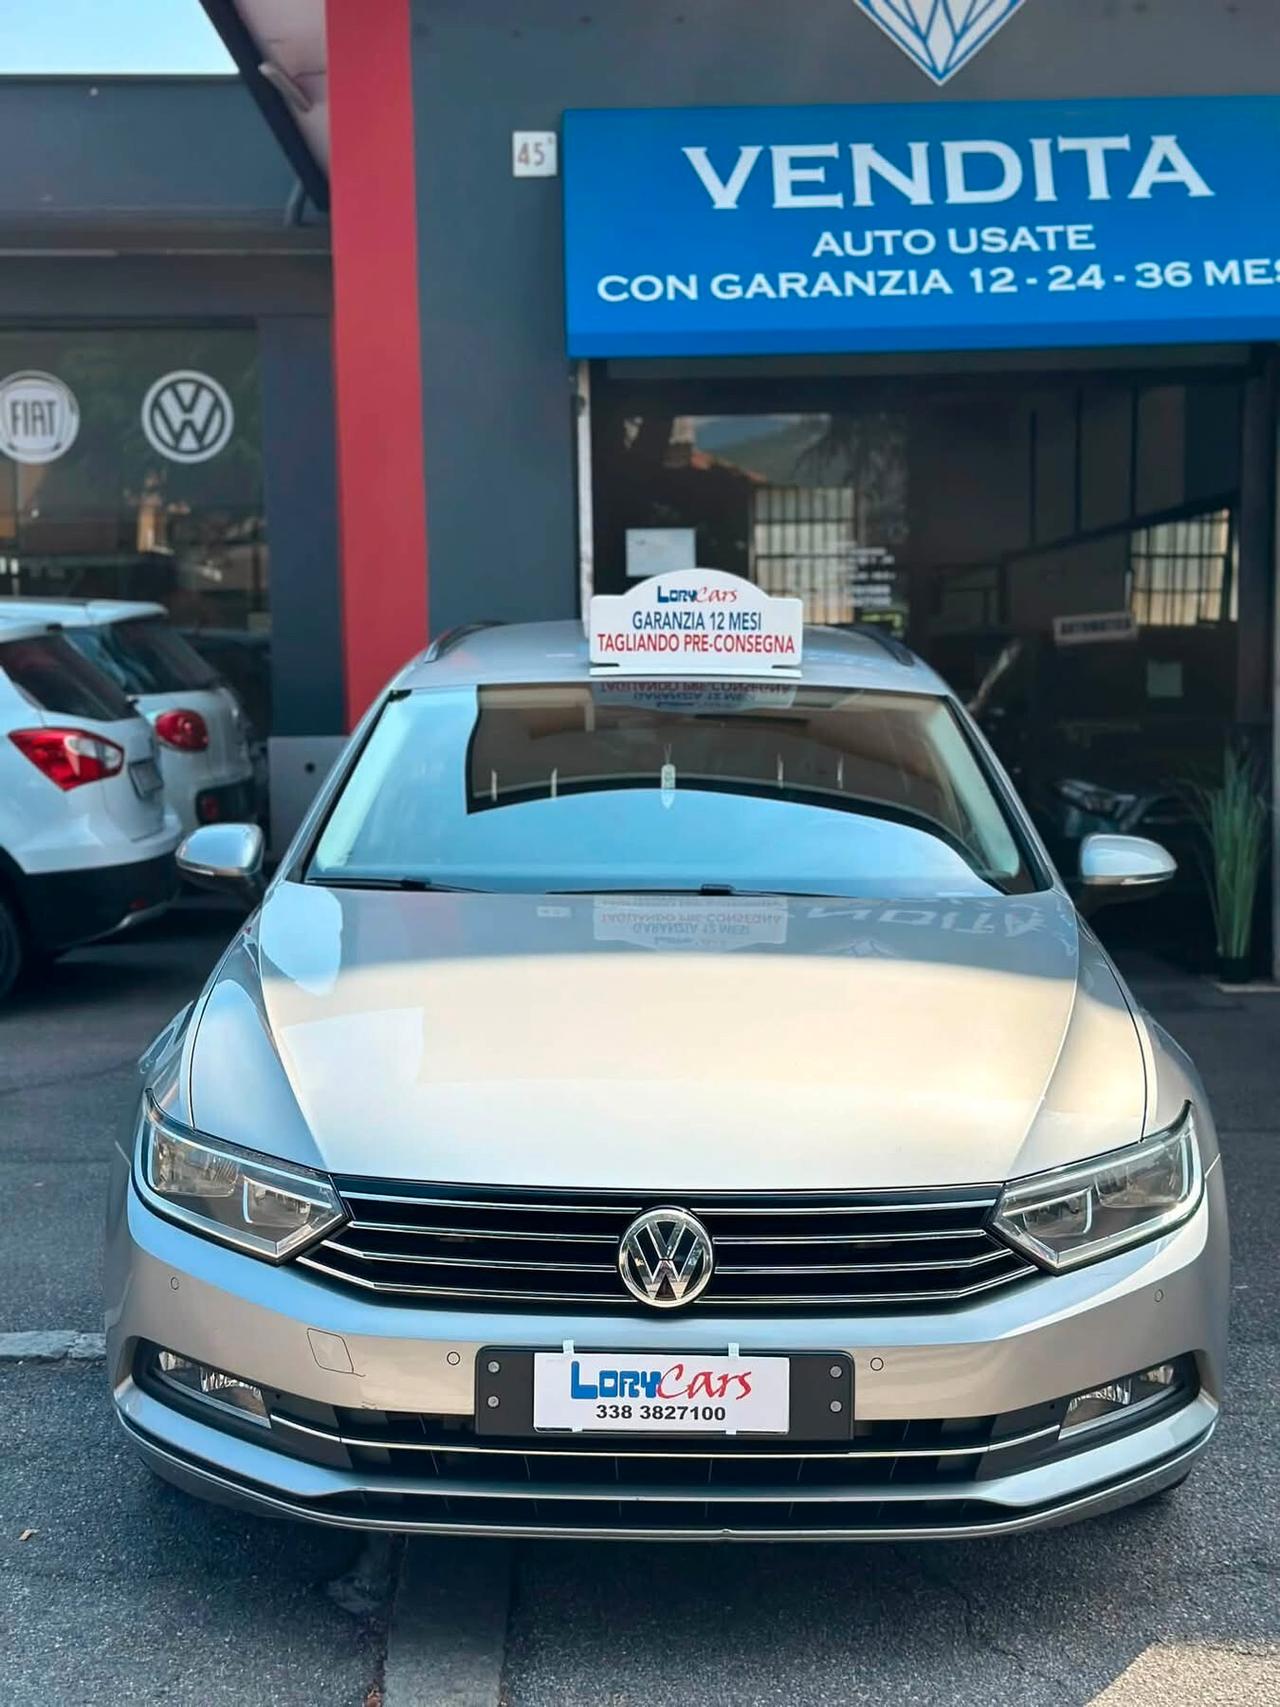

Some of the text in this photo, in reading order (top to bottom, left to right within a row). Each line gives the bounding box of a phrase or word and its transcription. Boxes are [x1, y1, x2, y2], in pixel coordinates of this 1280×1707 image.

[684, 136, 1213, 209] VENDITA
[813, 225, 1095, 257] AUTO USATE
[597, 275, 698, 302] CON
[710, 270, 952, 300] GARANZIA
[970, 268, 1017, 293] 12
[1048, 265, 1105, 291] 24
[1135, 261, 1192, 288] 36
[1204, 258, 1280, 286] ME
[10, 400, 57, 437] FIAT
[632, 610, 762, 632] GARANZIA 12 MESI
[597, 633, 795, 654] TAGLIANDO PRE-CONSEGNA
[595, 1404, 726, 1421] 338 3827100
